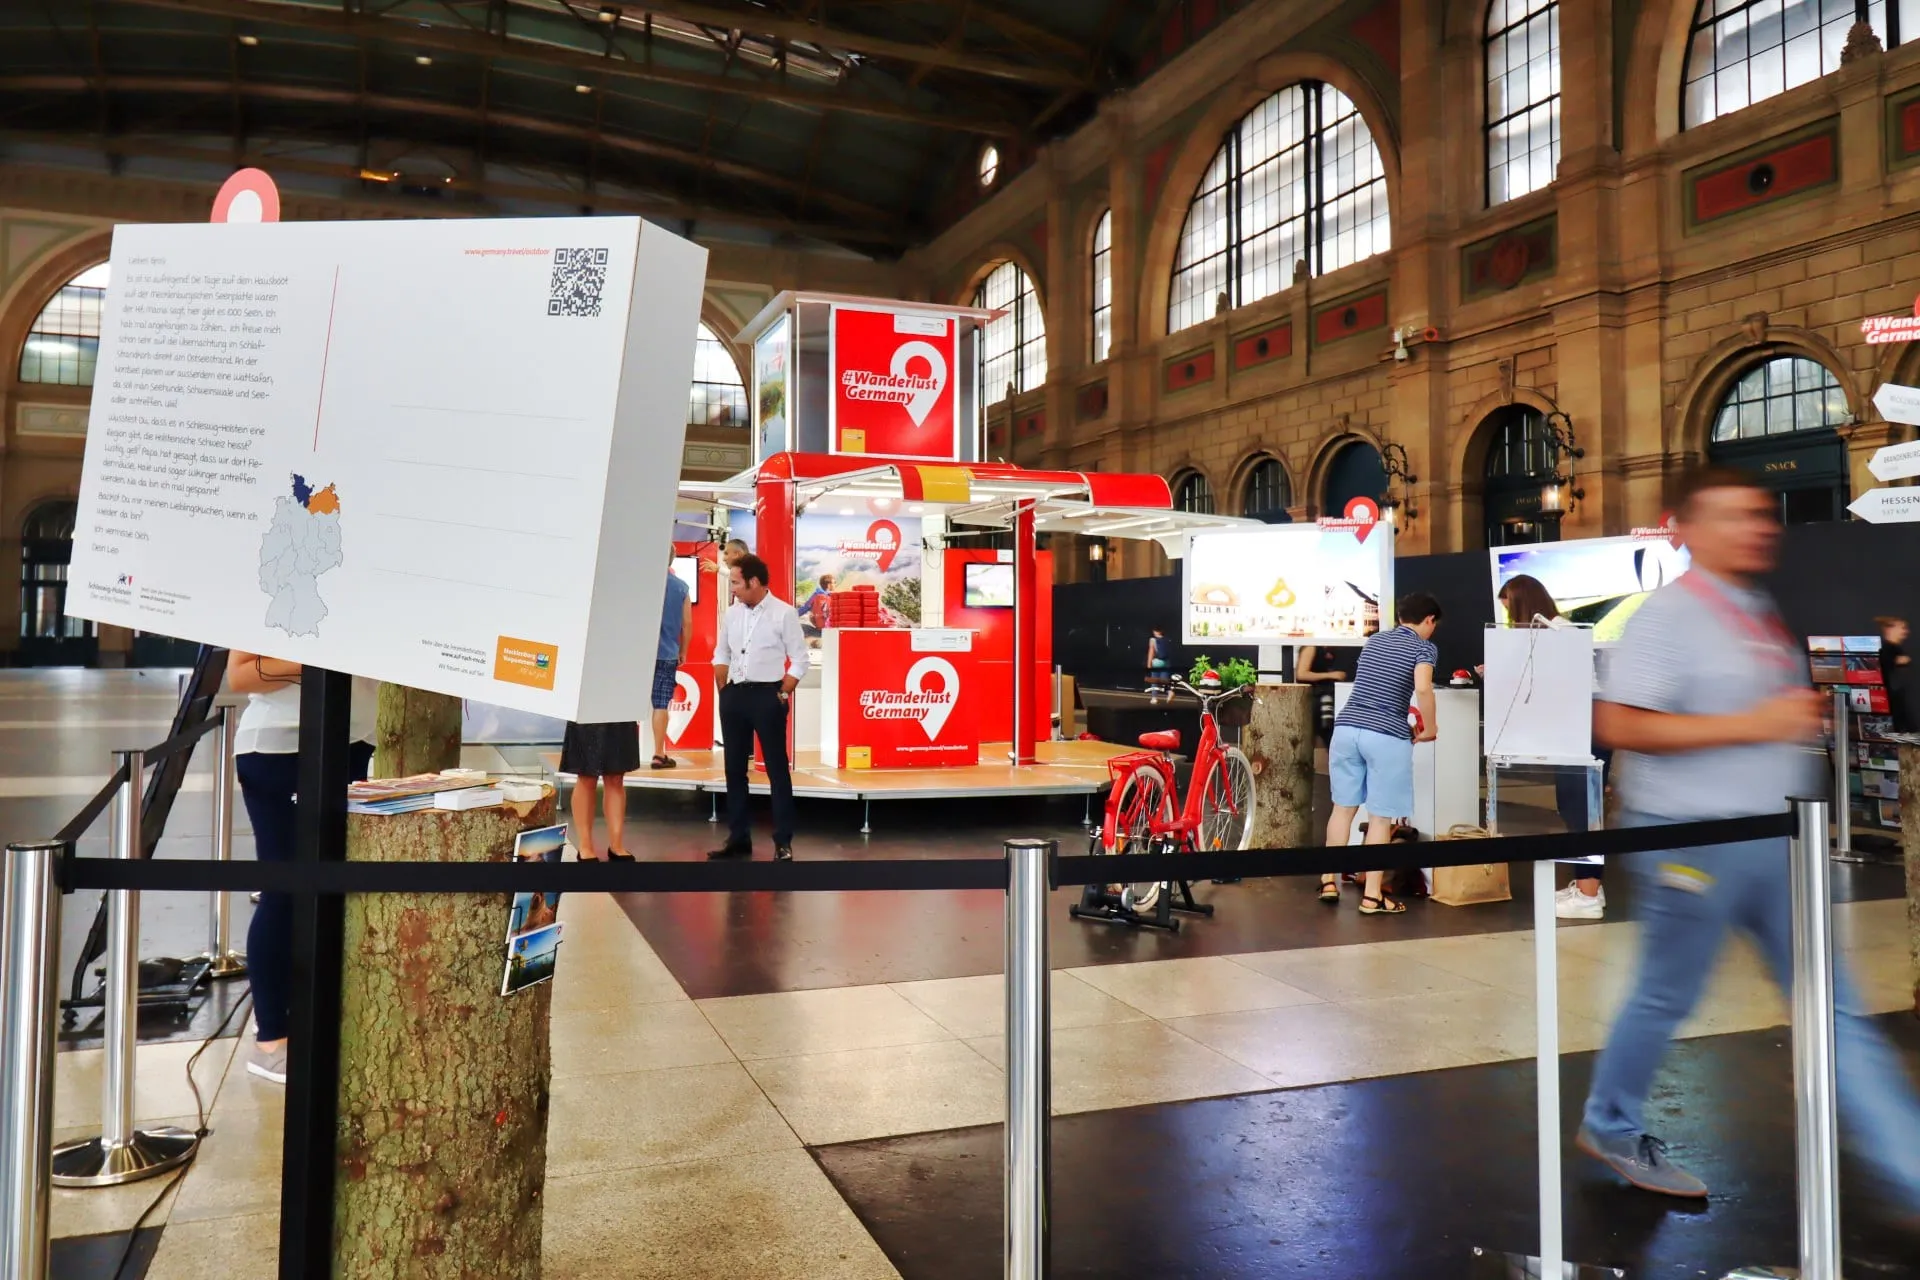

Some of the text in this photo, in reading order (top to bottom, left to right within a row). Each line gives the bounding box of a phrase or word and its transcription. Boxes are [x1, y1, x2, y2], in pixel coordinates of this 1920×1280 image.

[222, 274, 237, 285] auf
[254, 275, 288, 286] Hausboot
[215, 291, 253, 304] Seenplatte
[254, 293, 279, 302] waren
[148, 320, 189, 335] angefangen
[242, 322, 263, 334] freue
[264, 324, 282, 336] mich
[842, 370, 938, 391] #Wanderlust
[235, 389, 250, 399] und
[251, 390, 271, 400] See-
[847, 385, 915, 405] Germany
[151, 416, 168, 427] dass
[186, 420, 249, 437] Schleswig-Holstein
[250, 426, 266, 436] eine
[142, 446, 159, 461] Papa
[160, 448, 172, 458] hat
[199, 454, 217, 464] dass
[231, 455, 247, 467] dort
[1764, 460, 1797, 472] SNACK
[153, 463, 168, 474] und
[220, 472, 257, 485] antreffen
[171, 481, 185, 493] mal
[1881, 495, 1920, 505] HESSEN
[144, 499, 169, 509] meinen
[226, 510, 247, 520] wenn
[838, 540, 897, 551] #Wanderlust
[840, 550, 883, 562] Germany
[861, 691, 951, 705] #Wanderlust
[864, 706, 930, 721] Germany
